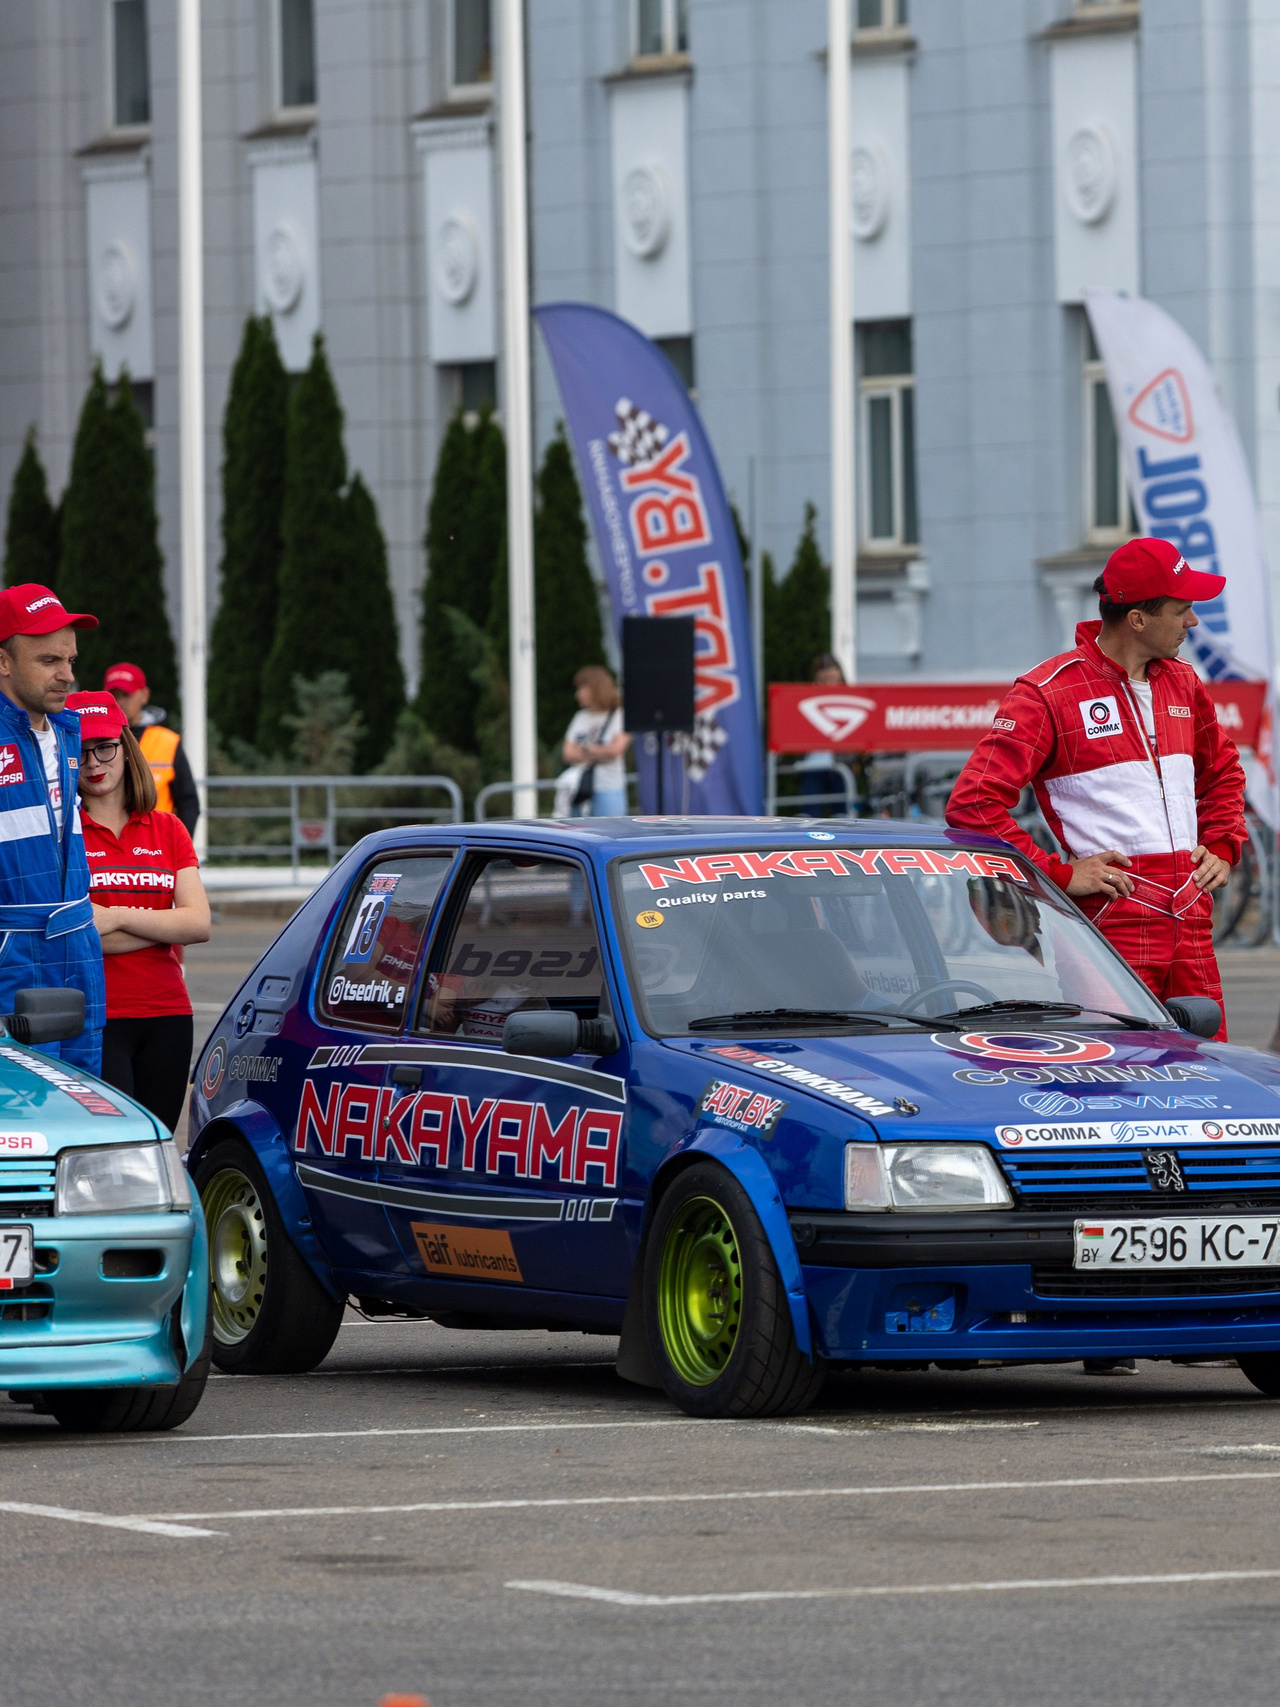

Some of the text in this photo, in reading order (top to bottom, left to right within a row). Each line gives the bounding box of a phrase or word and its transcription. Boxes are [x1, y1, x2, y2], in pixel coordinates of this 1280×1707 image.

[1170, 708, 1188, 716] RLG
[1088, 724, 1118, 735] COMMA
[638, 849, 1029, 891] NAKAYAMA
[656, 887, 767, 909] Quality parts
[350, 899, 387, 956] 13
[643, 914, 658, 924] OK
[229, 1055, 278, 1082] COMMA
[706, 1044, 896, 1117] ADTGYMKHANA
[953, 1064, 1220, 1086] COMMA
[702, 1083, 780, 1129] ADT.BY
[294, 1078, 625, 1188] NAKAYAMA
[713, 1115, 749, 1132] АВТОПОРТАЛ
[1024, 1126, 1100, 1142] COMMA
[1134, 1124, 1189, 1138] SVIAT
[416, 1231, 518, 1274] Taif lubricants
[1110, 1223, 1278, 1263] 2596 KC-7
[1081, 1248, 1100, 1263] BY
